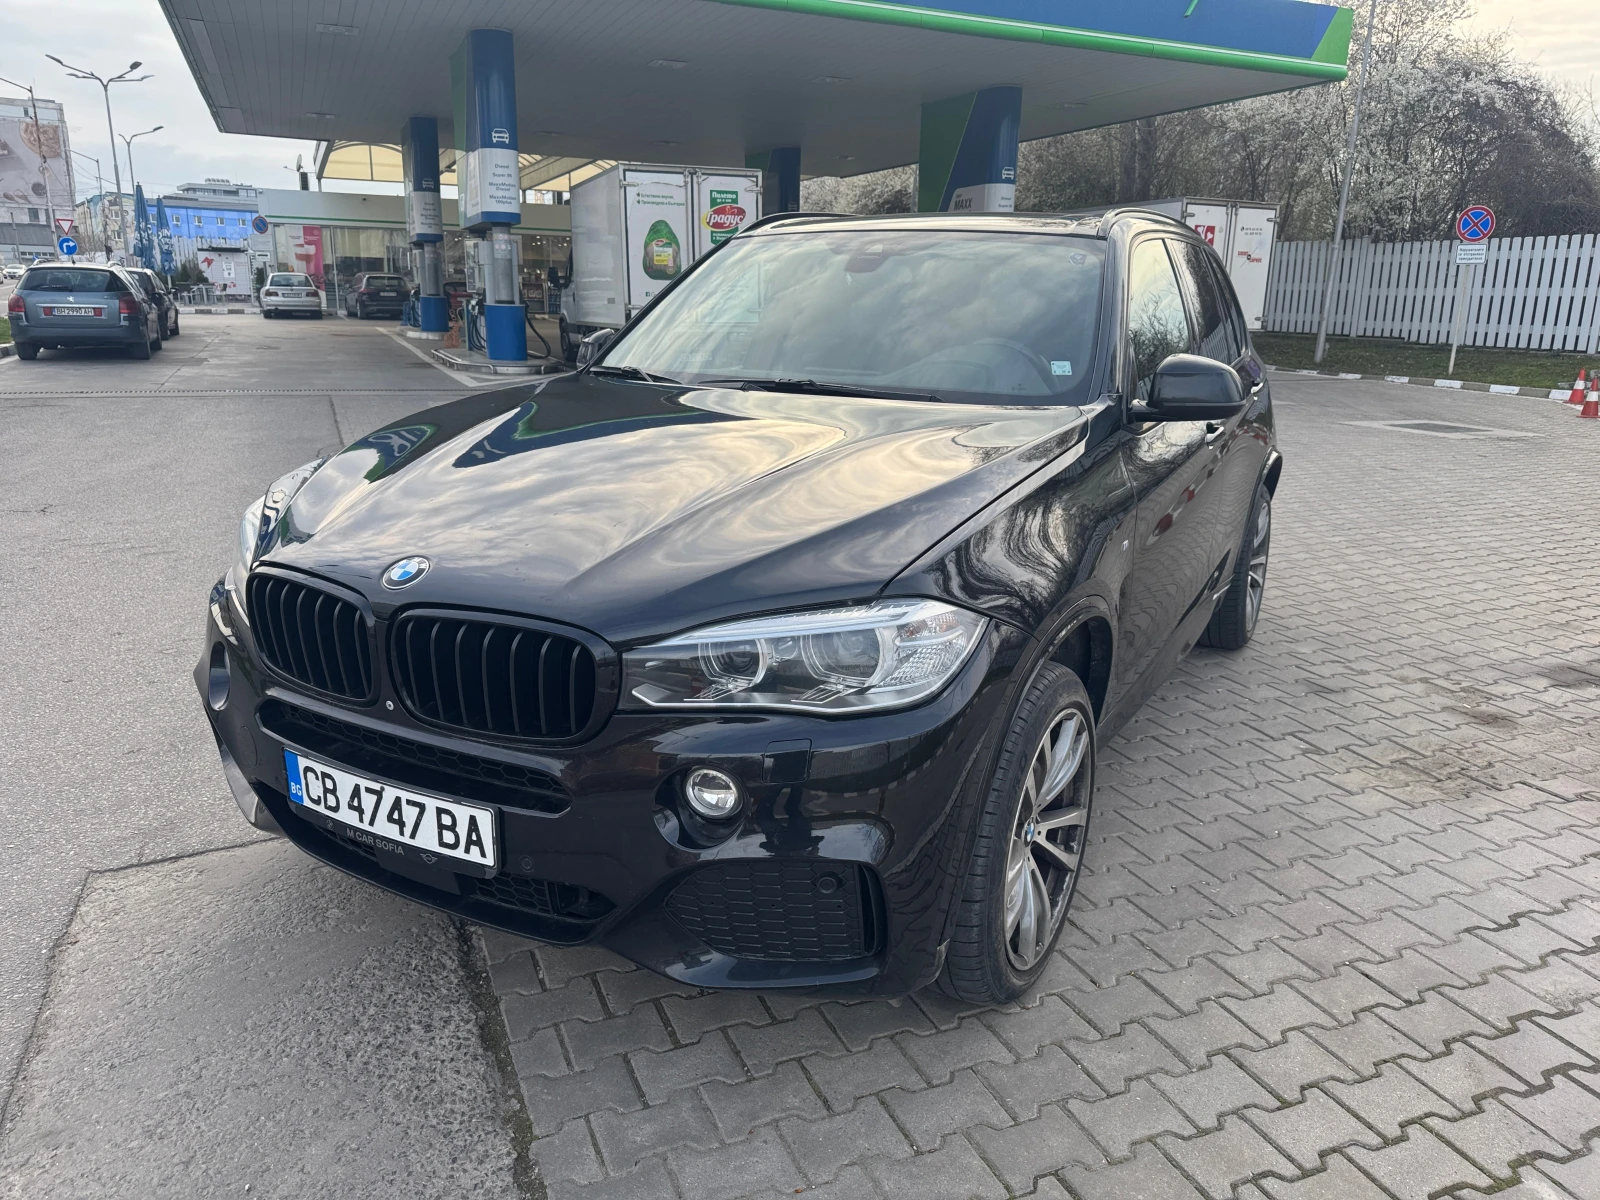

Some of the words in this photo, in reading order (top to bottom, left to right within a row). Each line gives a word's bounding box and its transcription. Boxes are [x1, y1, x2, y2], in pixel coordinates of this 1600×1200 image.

[954, 198, 973, 210] MAXX
[706, 211, 744, 227] Градус
[290, 781, 302, 796] BG
[303, 765, 340, 814] CB
[347, 783, 427, 840] 4747
[435, 805, 487, 859] BA
[346, 827, 355, 839] M
[355, 832, 374, 846] CAR
[375, 839, 405, 856] SOFIA
